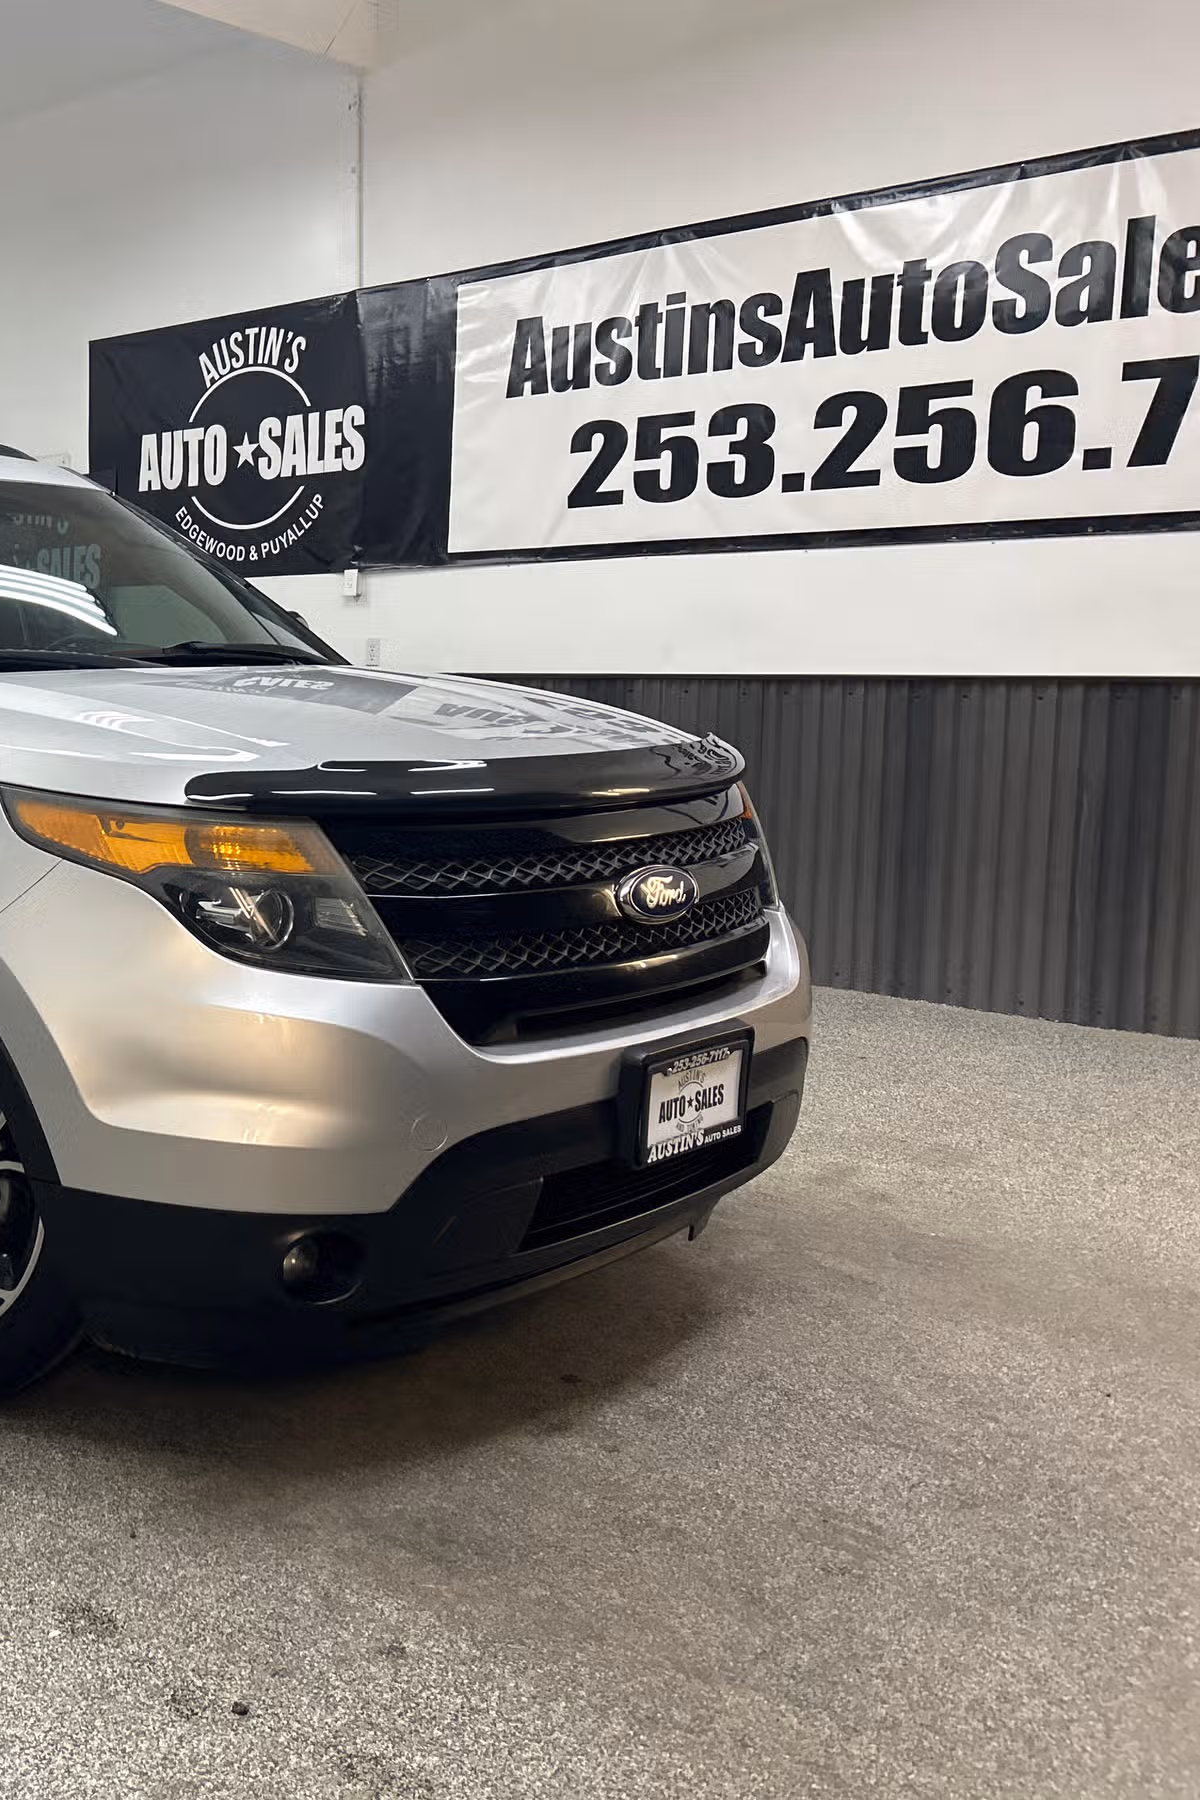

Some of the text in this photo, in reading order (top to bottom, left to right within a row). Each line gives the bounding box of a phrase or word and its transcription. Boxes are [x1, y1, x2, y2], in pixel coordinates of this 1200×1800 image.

[505, 215, 1200, 398] AustinsAutoSale
[198, 327, 306, 388] AUSTIN'S
[138, 405, 366, 492] AUTO SALES
[567, 355, 1200, 509] 253.256.7
[175, 493, 325, 562] EDGEWOOD & PUYALLUP
[640, 875, 686, 910] Ford
[658, 1083, 725, 1124] AUTO SALES
[647, 1125, 742, 1164] AUSTIN'S AUTO SALES
